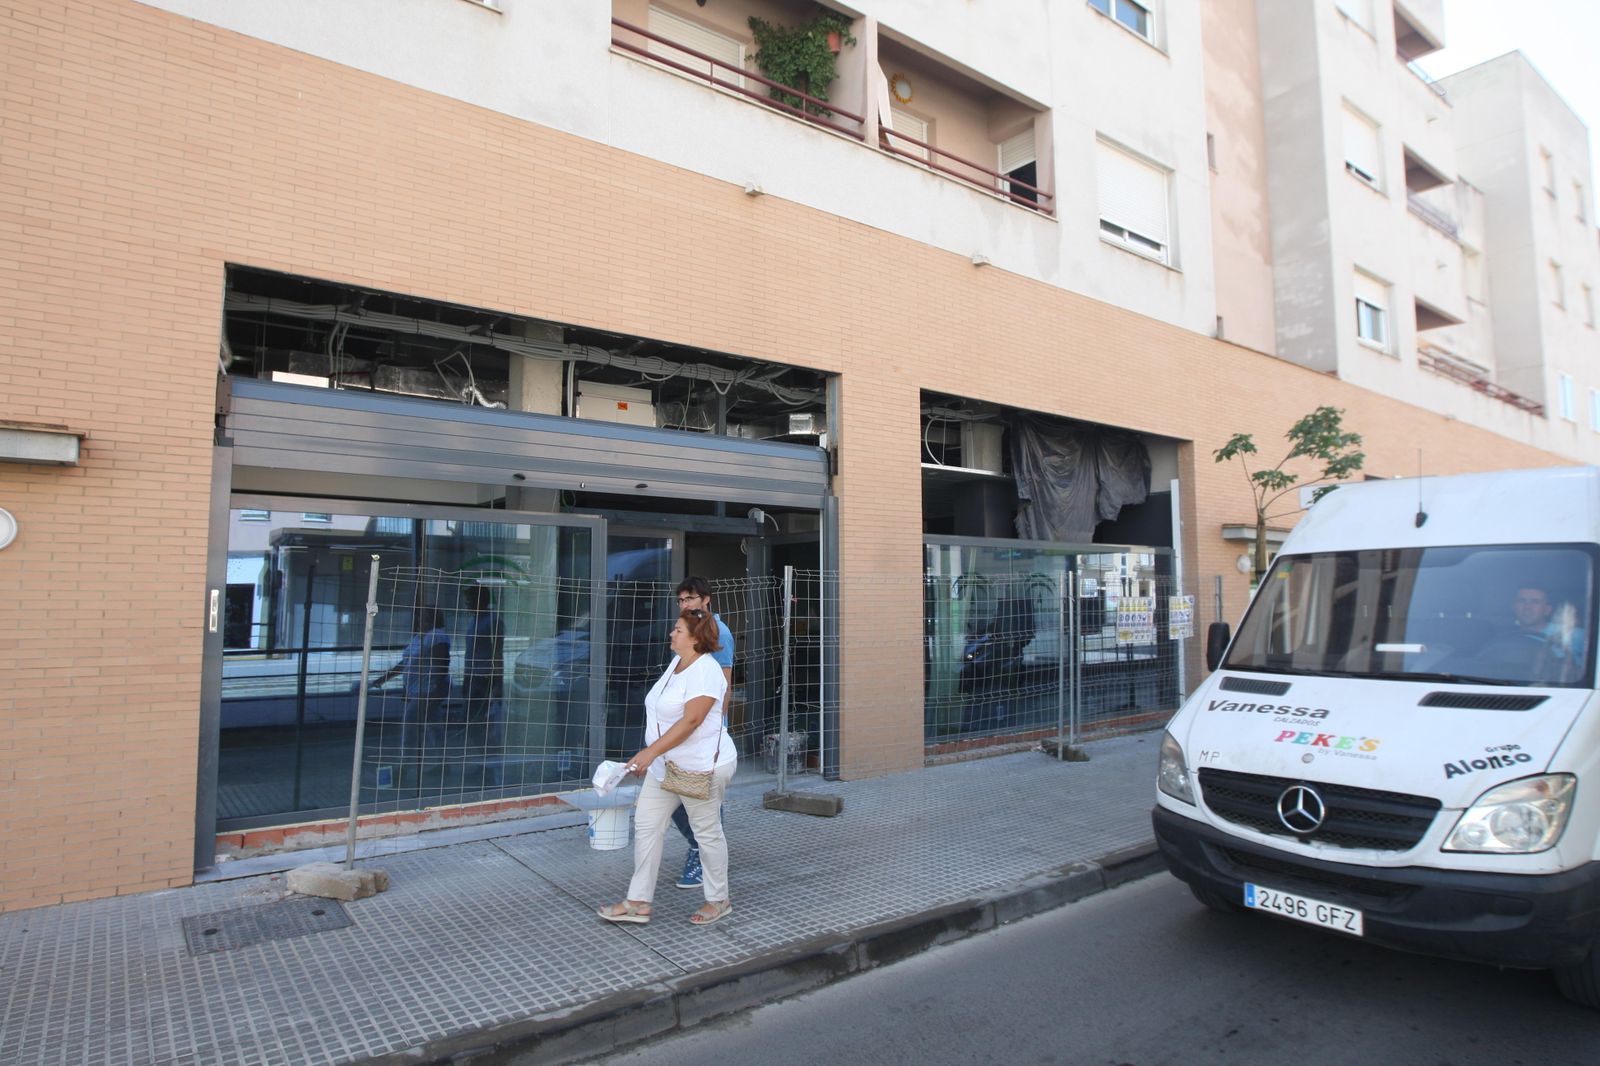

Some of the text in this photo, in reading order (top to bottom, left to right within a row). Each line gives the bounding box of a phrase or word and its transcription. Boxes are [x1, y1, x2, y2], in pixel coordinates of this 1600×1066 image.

[1207, 700, 1331, 719] Vanessa
[1273, 717, 1321, 727] CALZADOS
[1274, 730, 1381, 752] PEKE'S
[1485, 744, 1521, 753] Grupo
[1317, 748, 1378, 761] by Vanessa
[1443, 752, 1533, 779] Alonso
[1259, 889, 1357, 932] 2496 GFZ
